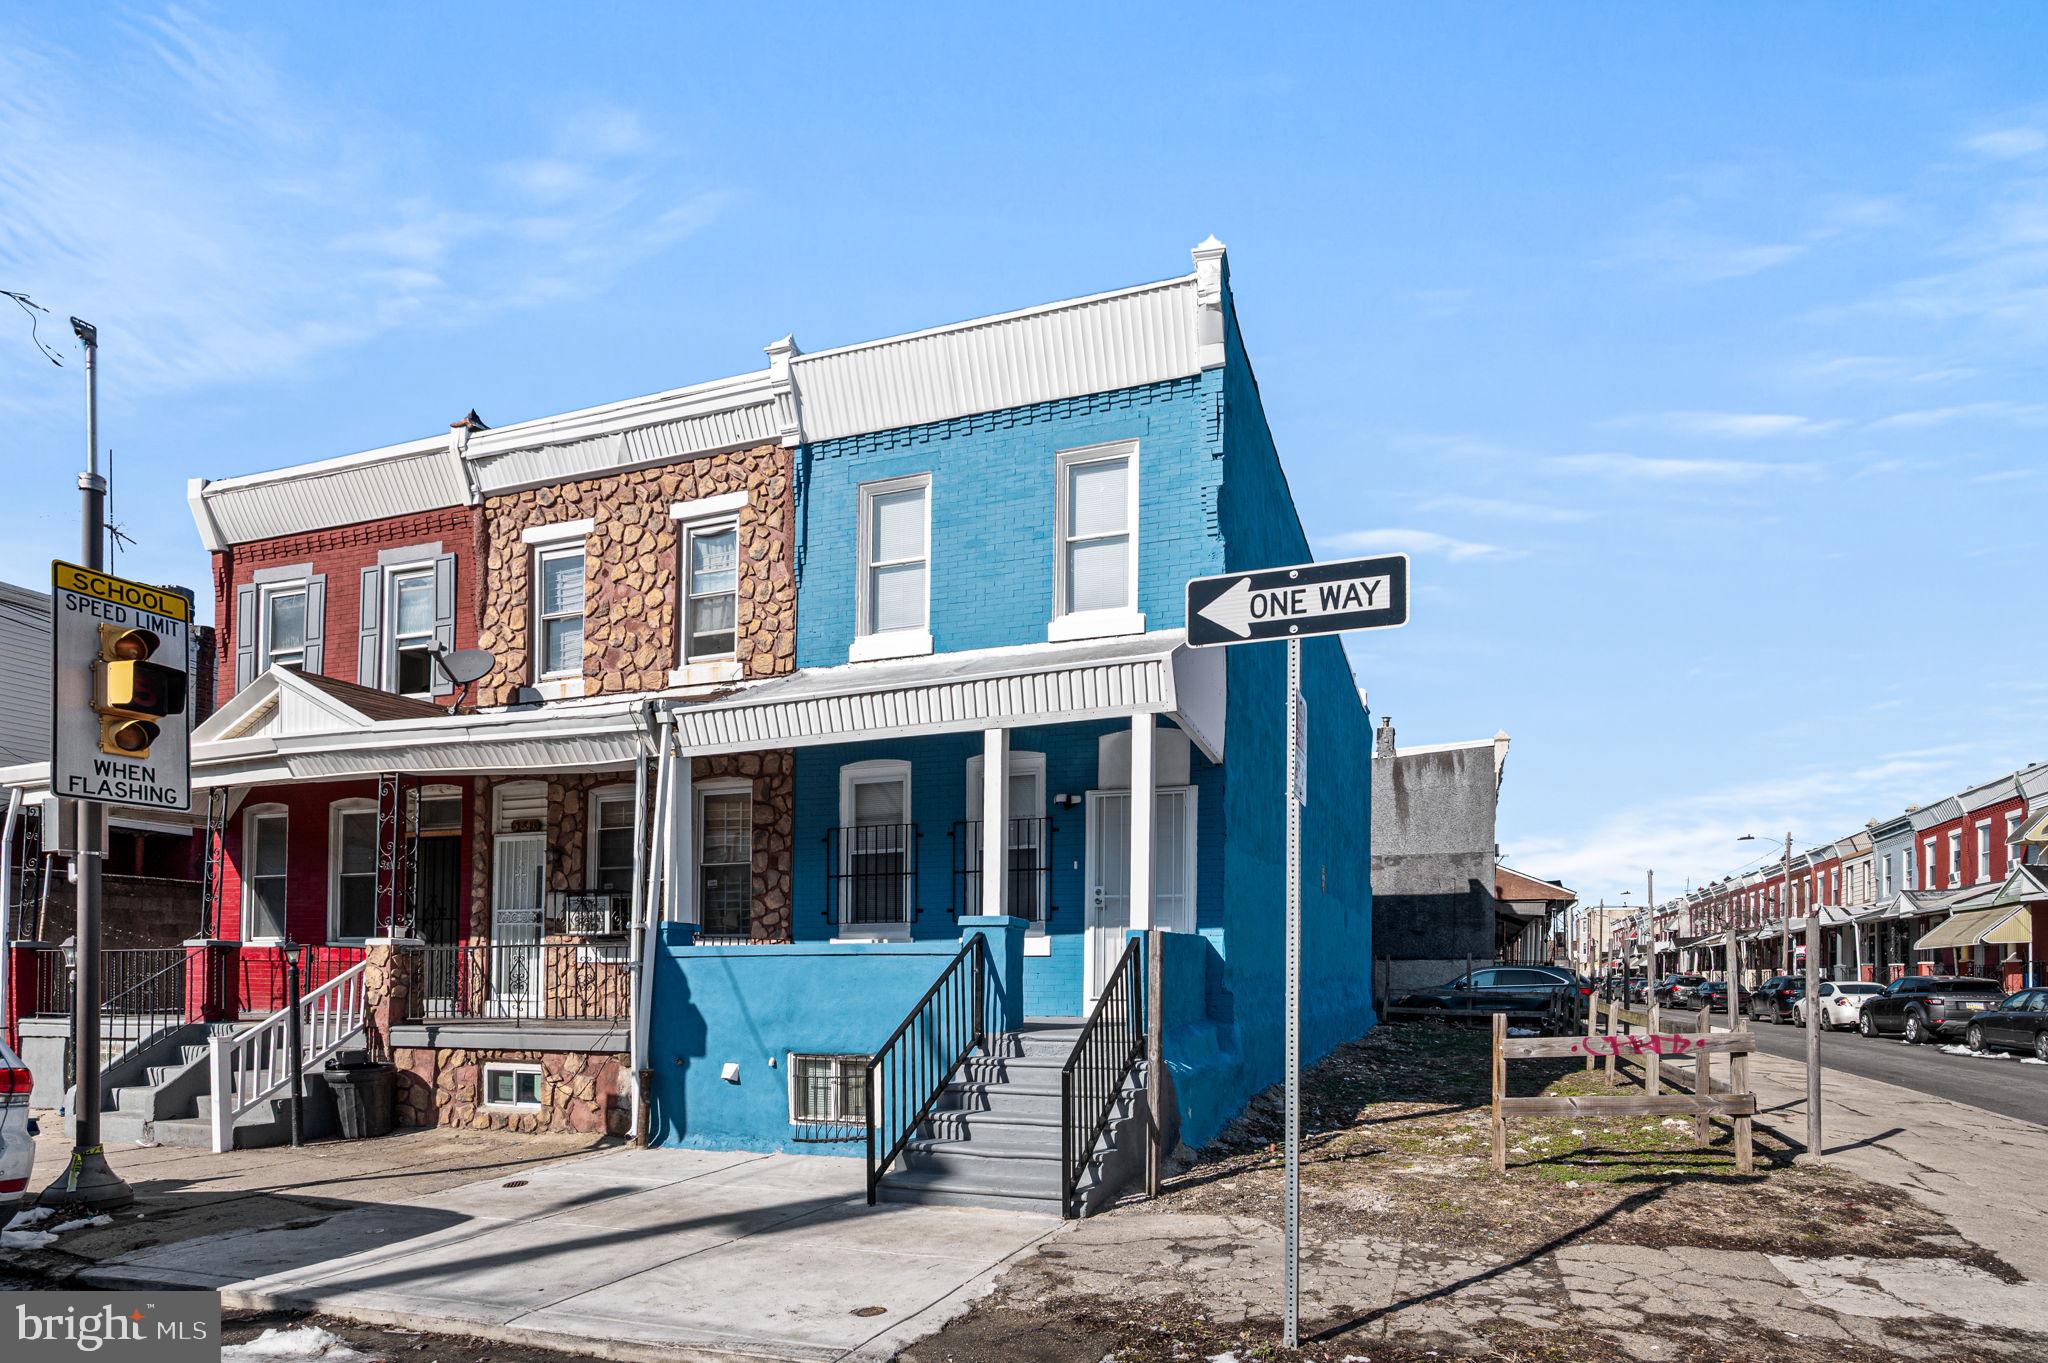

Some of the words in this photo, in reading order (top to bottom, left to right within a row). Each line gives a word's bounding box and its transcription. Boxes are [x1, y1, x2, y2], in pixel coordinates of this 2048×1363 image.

[72, 572, 174, 615] SCHOOL
[1249, 588, 1308, 619] ONE
[1319, 579, 1382, 612] WAY
[65, 593, 127, 623] SPEED
[135, 611, 179, 637] LIMIT
[68, 775, 177, 805] FLASHING
[93, 759, 156, 784] WHEN
